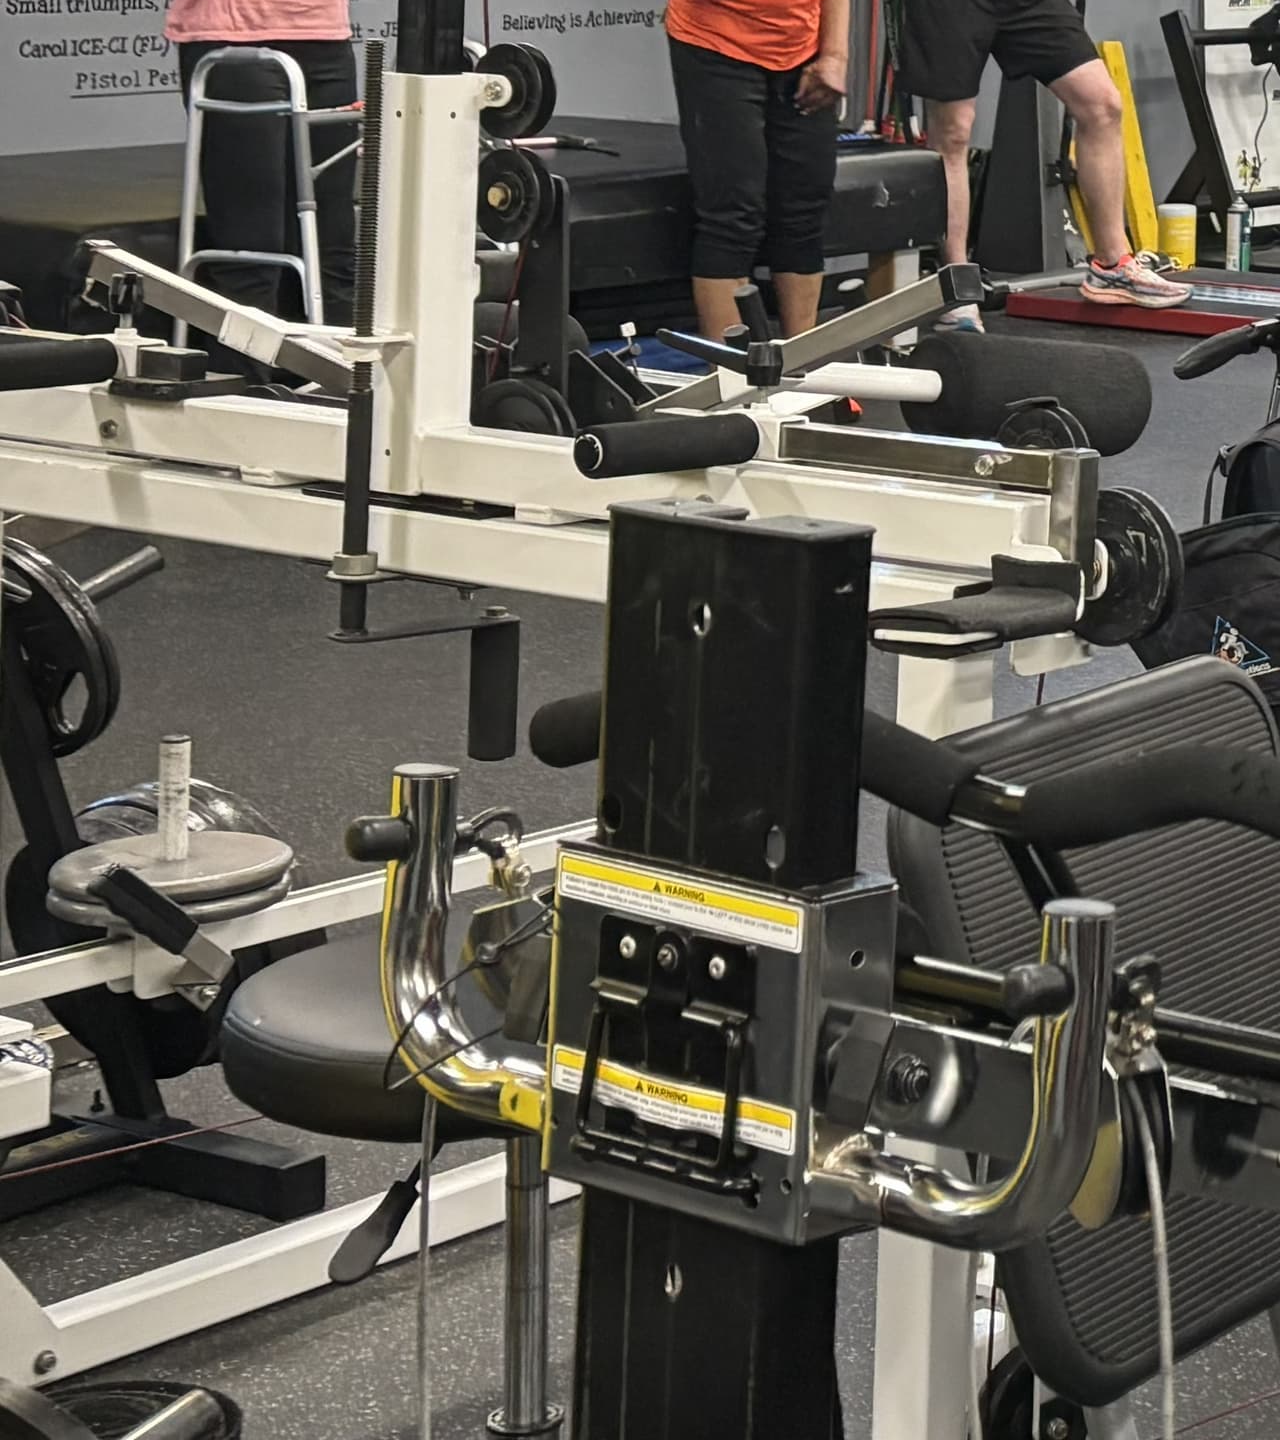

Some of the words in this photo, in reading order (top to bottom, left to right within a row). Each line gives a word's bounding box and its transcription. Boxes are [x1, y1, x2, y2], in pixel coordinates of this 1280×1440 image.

[502, 13, 566, 34] Believing
[569, 12, 582, 29] is
[19, 38, 68, 59] Carol
[132, 35, 171, 58] (FL)
[75, 69, 141, 91] Pistol
[148, 68, 178, 88] Pet
[664, 883, 706, 903] WARNING
[646, 1084, 689, 1104] WARNING
